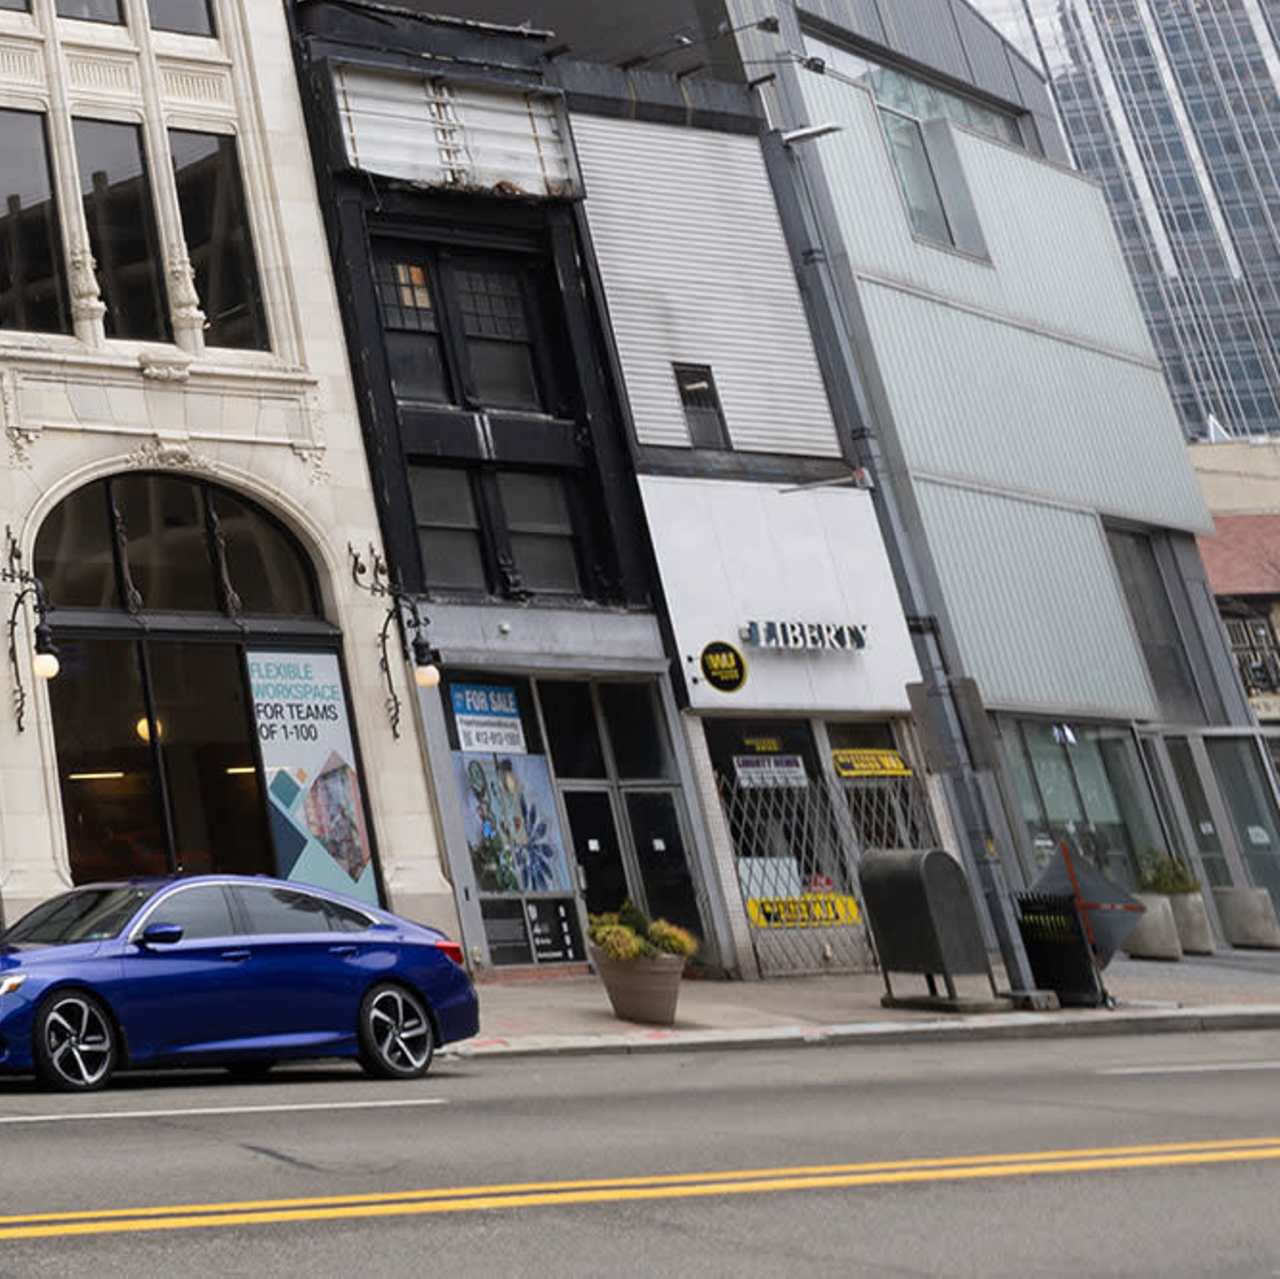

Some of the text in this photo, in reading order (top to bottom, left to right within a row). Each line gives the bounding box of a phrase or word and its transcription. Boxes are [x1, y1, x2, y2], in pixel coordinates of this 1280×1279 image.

[748, 620, 867, 651] LIBERTY
[250, 662, 312, 679] FLEXIBLE
[254, 682, 339, 701] WORKSPACE
[464, 689, 489, 712] FOR
[489, 690, 518, 715] SALE
[255, 703, 338, 721] FOR TEAMS
[259, 723, 318, 742] OF 1-100
